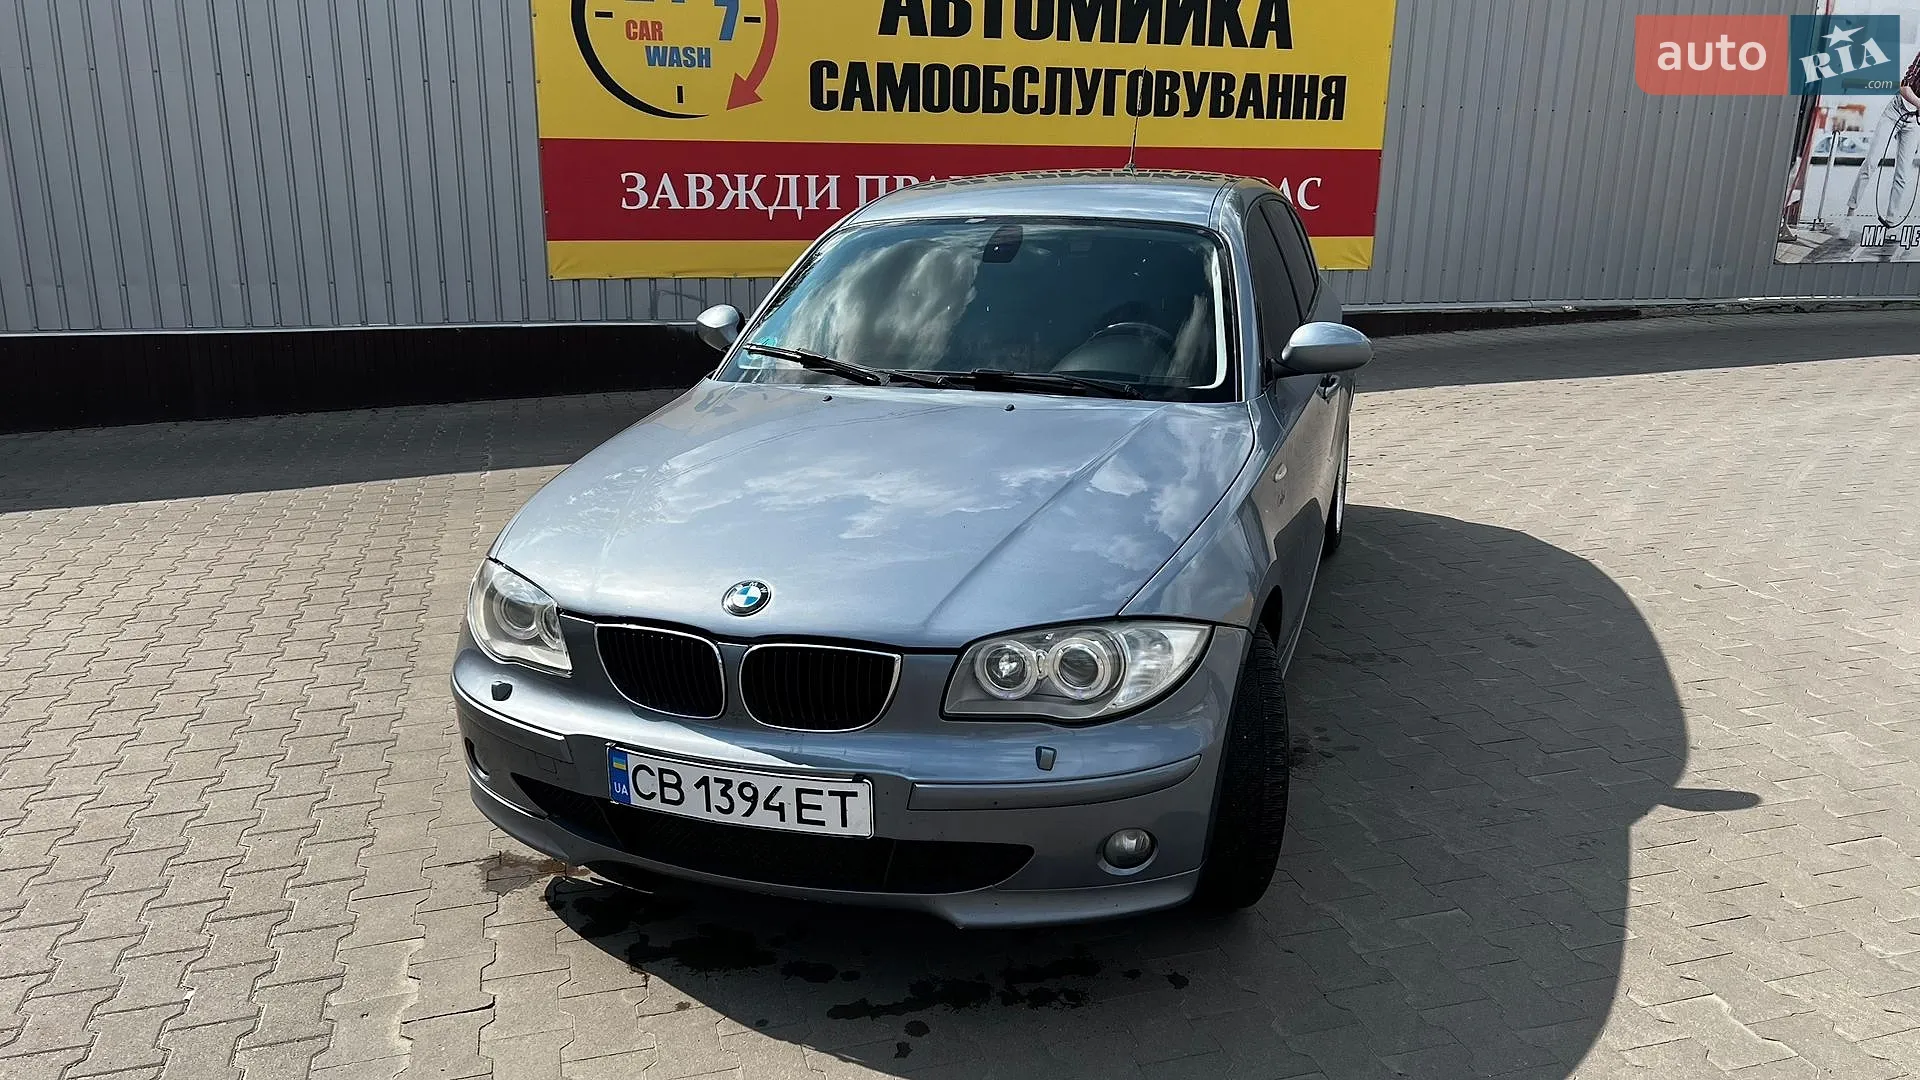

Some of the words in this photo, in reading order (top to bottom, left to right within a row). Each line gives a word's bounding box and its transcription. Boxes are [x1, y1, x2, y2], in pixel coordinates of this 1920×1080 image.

[625, 19, 664, 41] CAR
[644, 45, 711, 68] WASH
[809, 60, 1347, 121] САМООБСЛУГОВУВАННЯ
[619, 172, 841, 220] ЗАВЖДИ
[1279, 177, 1322, 211] АС
[1860, 225, 1886, 247] МИ
[614, 781, 629, 796] UA
[631, 763, 685, 806] CB
[693, 775, 786, 822] 1394
[795, 787, 858, 828] ET
